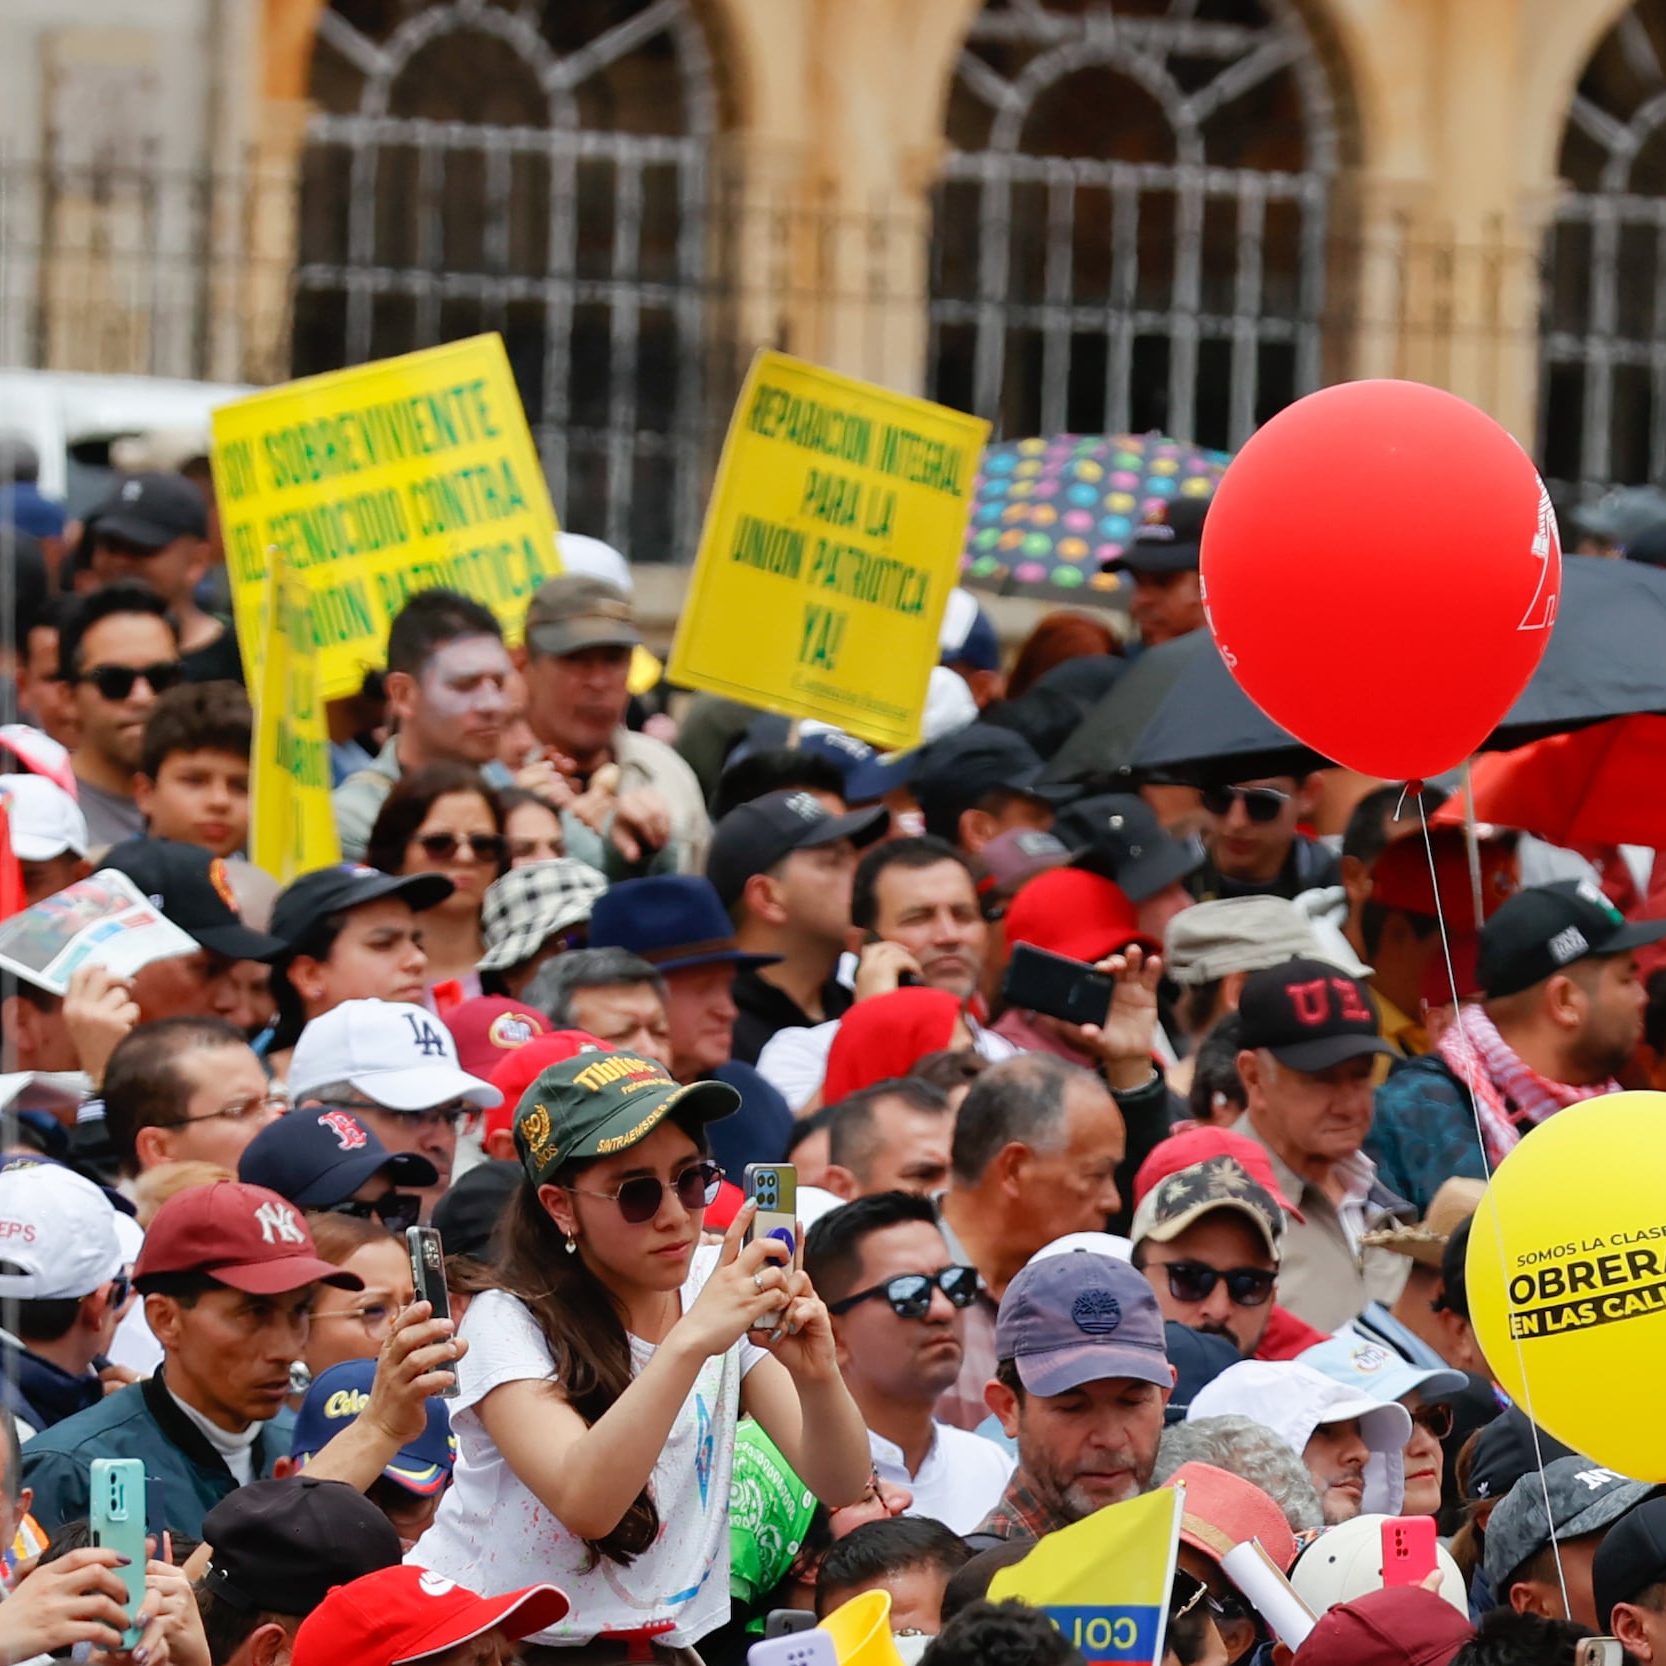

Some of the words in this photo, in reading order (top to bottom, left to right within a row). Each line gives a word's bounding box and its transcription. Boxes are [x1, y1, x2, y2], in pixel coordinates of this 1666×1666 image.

[263, 378, 498, 490] SOBREVIVIENTE
[878, 422, 963, 498] INTEGRAL
[267, 486, 410, 571] GENOCIDIO
[409, 456, 530, 538] CONTRA
[800, 465, 861, 527] PARA
[865, 487, 899, 541] LA
[730, 512, 807, 581] UNIÓN
[797, 600, 849, 671] YA!
[403, 1013, 448, 1057] LA
[255, 1201, 307, 1244] NY
[1517, 1242, 1577, 1268] SOMOS
[1581, 1237, 1606, 1253] LA
[1510, 1314, 1540, 1338] EN
[1545, 1302, 1597, 1332] LAS
